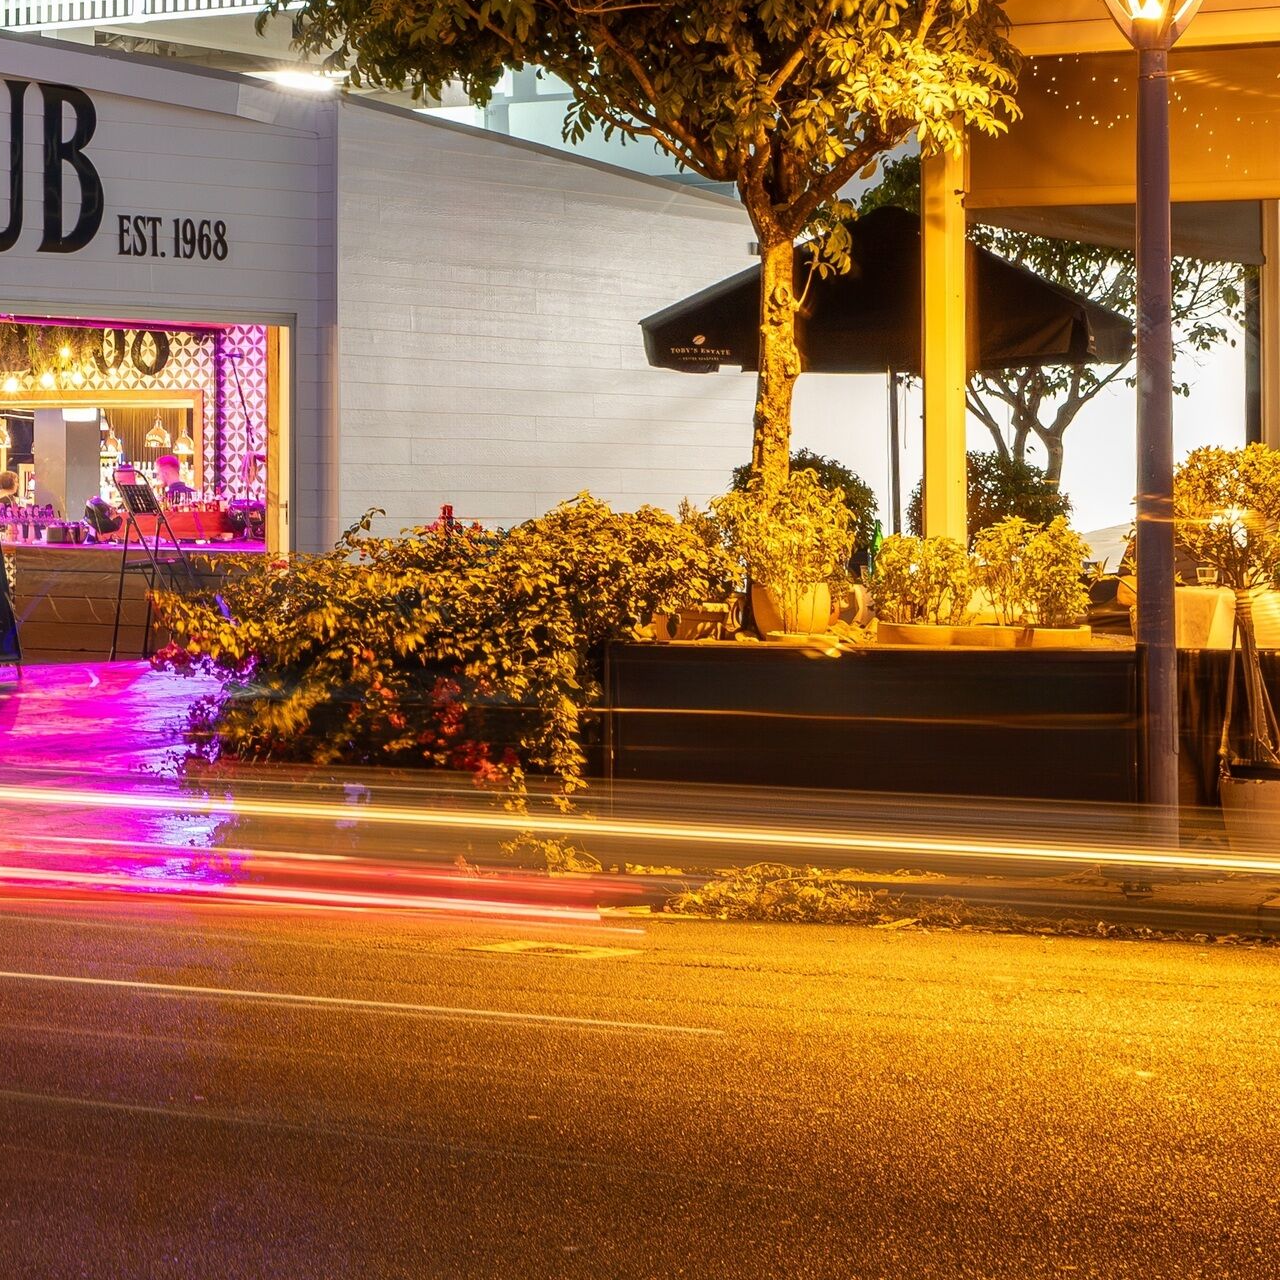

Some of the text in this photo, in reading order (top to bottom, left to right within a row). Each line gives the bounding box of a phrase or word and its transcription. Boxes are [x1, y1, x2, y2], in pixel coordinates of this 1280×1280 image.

[116, 215, 229, 261] EST. 1968
[700, 347, 731, 356] ESTATE
